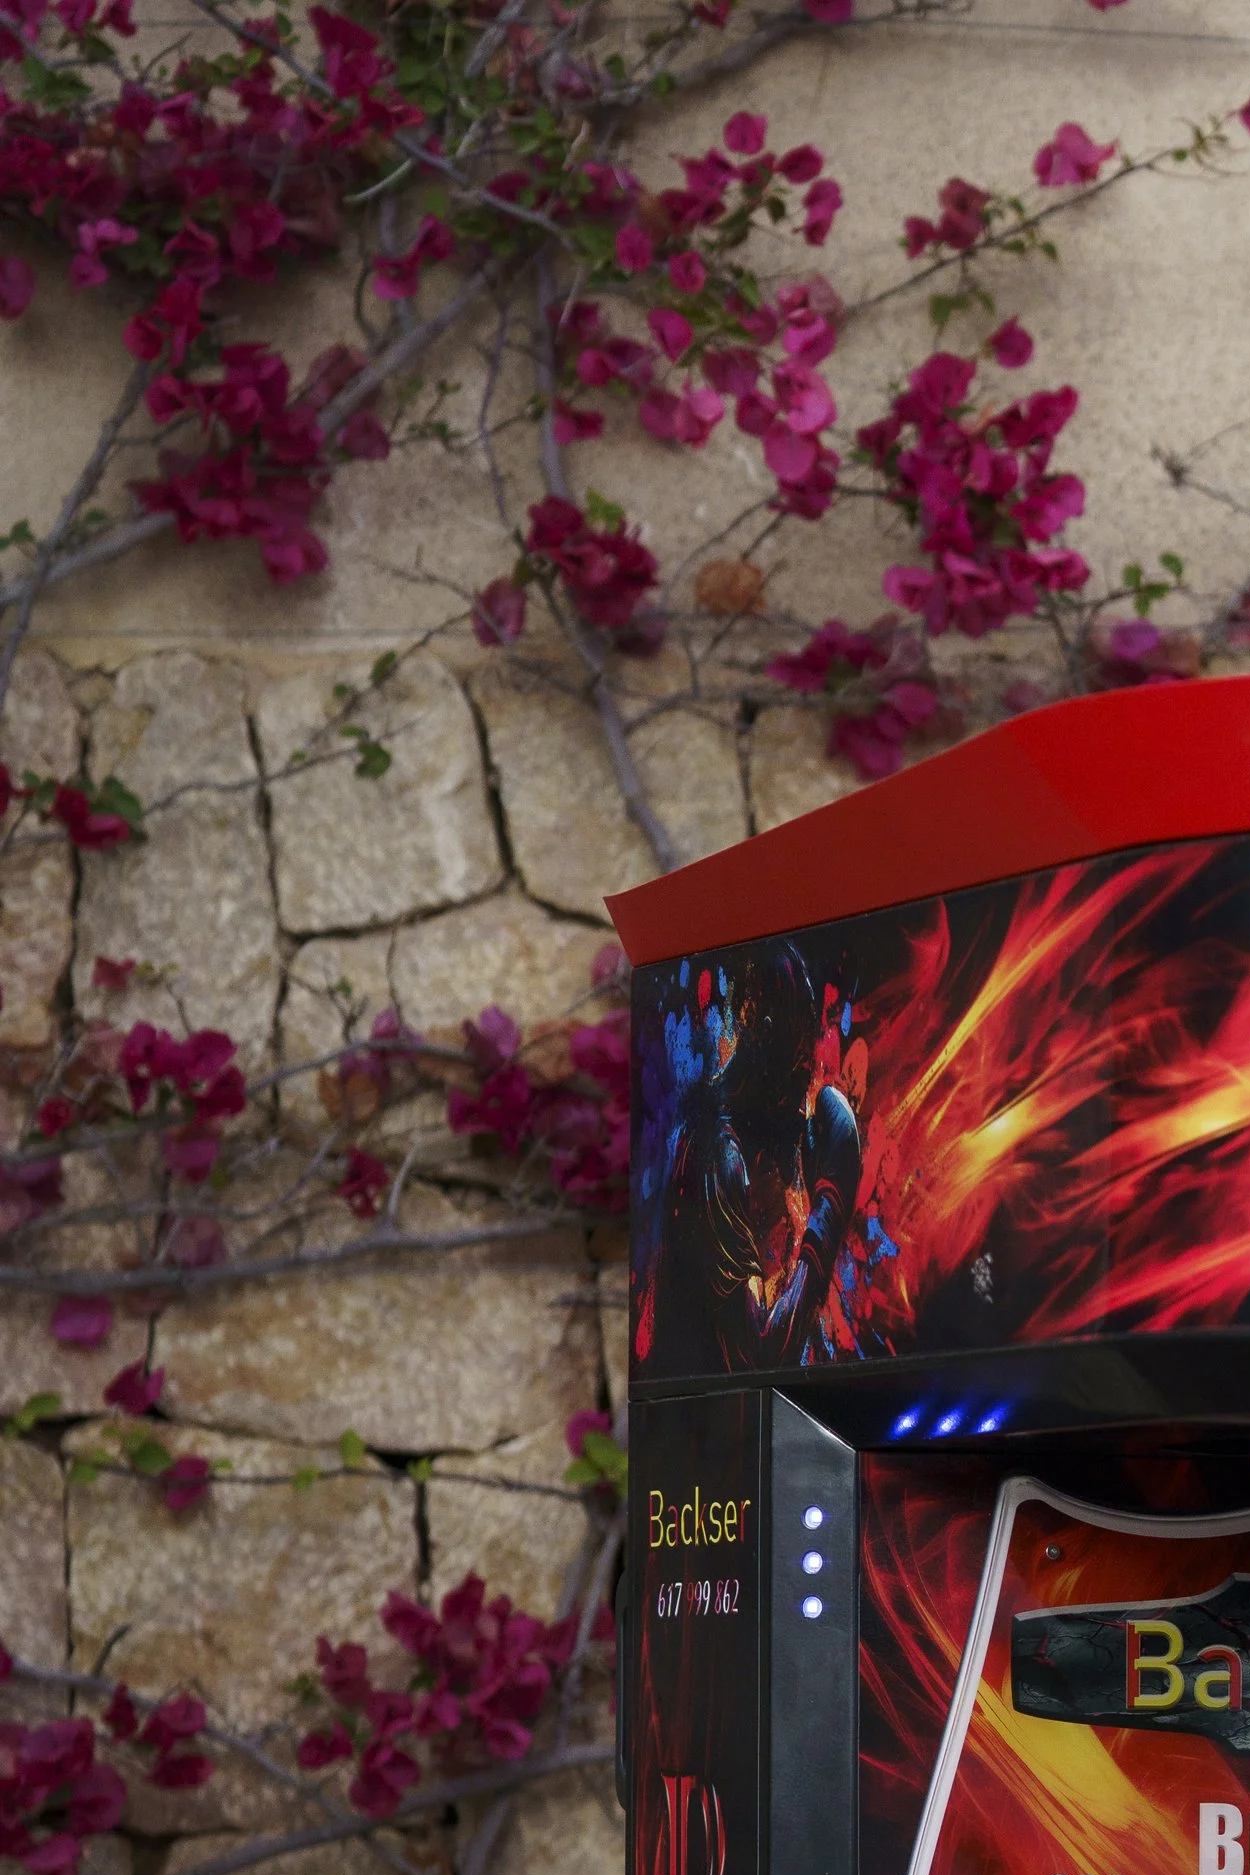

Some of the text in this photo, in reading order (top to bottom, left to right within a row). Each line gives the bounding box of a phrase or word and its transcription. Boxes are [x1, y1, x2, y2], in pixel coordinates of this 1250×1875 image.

[650, 1486, 751, 1548] Backser
[658, 1579, 739, 1617] 617 999 862
